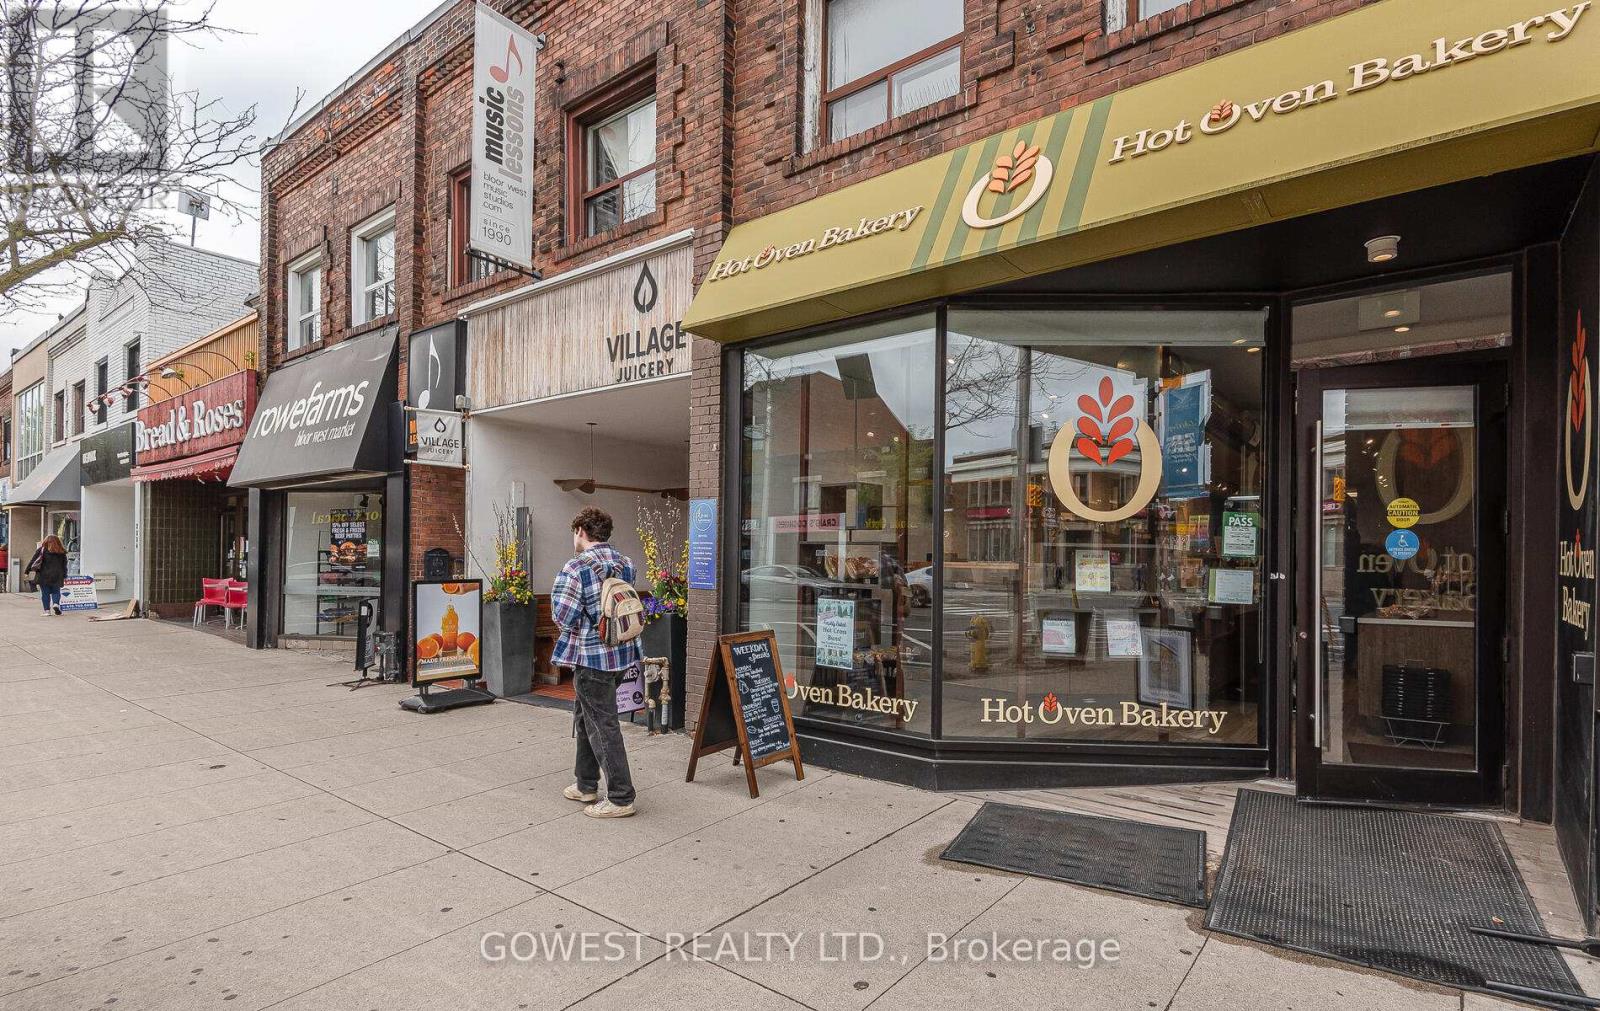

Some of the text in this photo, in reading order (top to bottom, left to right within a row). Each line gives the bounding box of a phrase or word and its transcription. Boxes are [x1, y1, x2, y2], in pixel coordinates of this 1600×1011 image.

[1107, 1, 1592, 166] Hot Oven Bakery
[479, 86, 504, 165] music
[501, 86, 525, 183] lessons
[483, 171, 528, 197] bloor west
[483, 182, 508, 198] music
[482, 201, 503, 214] com
[483, 191, 514, 210] studios
[482, 226, 512, 246] 1990
[483, 218, 511, 233] since
[708, 205, 924, 283] Hot Oven Bakery
[607, 321, 687, 362] VILLAGE
[616, 357, 674, 382] JUICERY
[253, 381, 369, 438] rowefarms
[135, 400, 244, 452] Bread & Roses
[328, 420, 356, 441] market
[421, 436, 460, 449] VILLAGE
[427, 447, 455, 455] JUICERY
[1228, 516, 1253, 527] PASS
[1559, 541, 1595, 580] Hot Oven
[1562, 586, 1592, 641] Bakery
[417, 658, 438, 666] MADE
[439, 655, 457, 663] FRESH
[733, 643, 768, 656] WEEKDAY
[786, 676, 833, 704] Oven
[837, 683, 918, 723] Bakery
[980, 697, 1228, 734] Hot Oven Bakery
